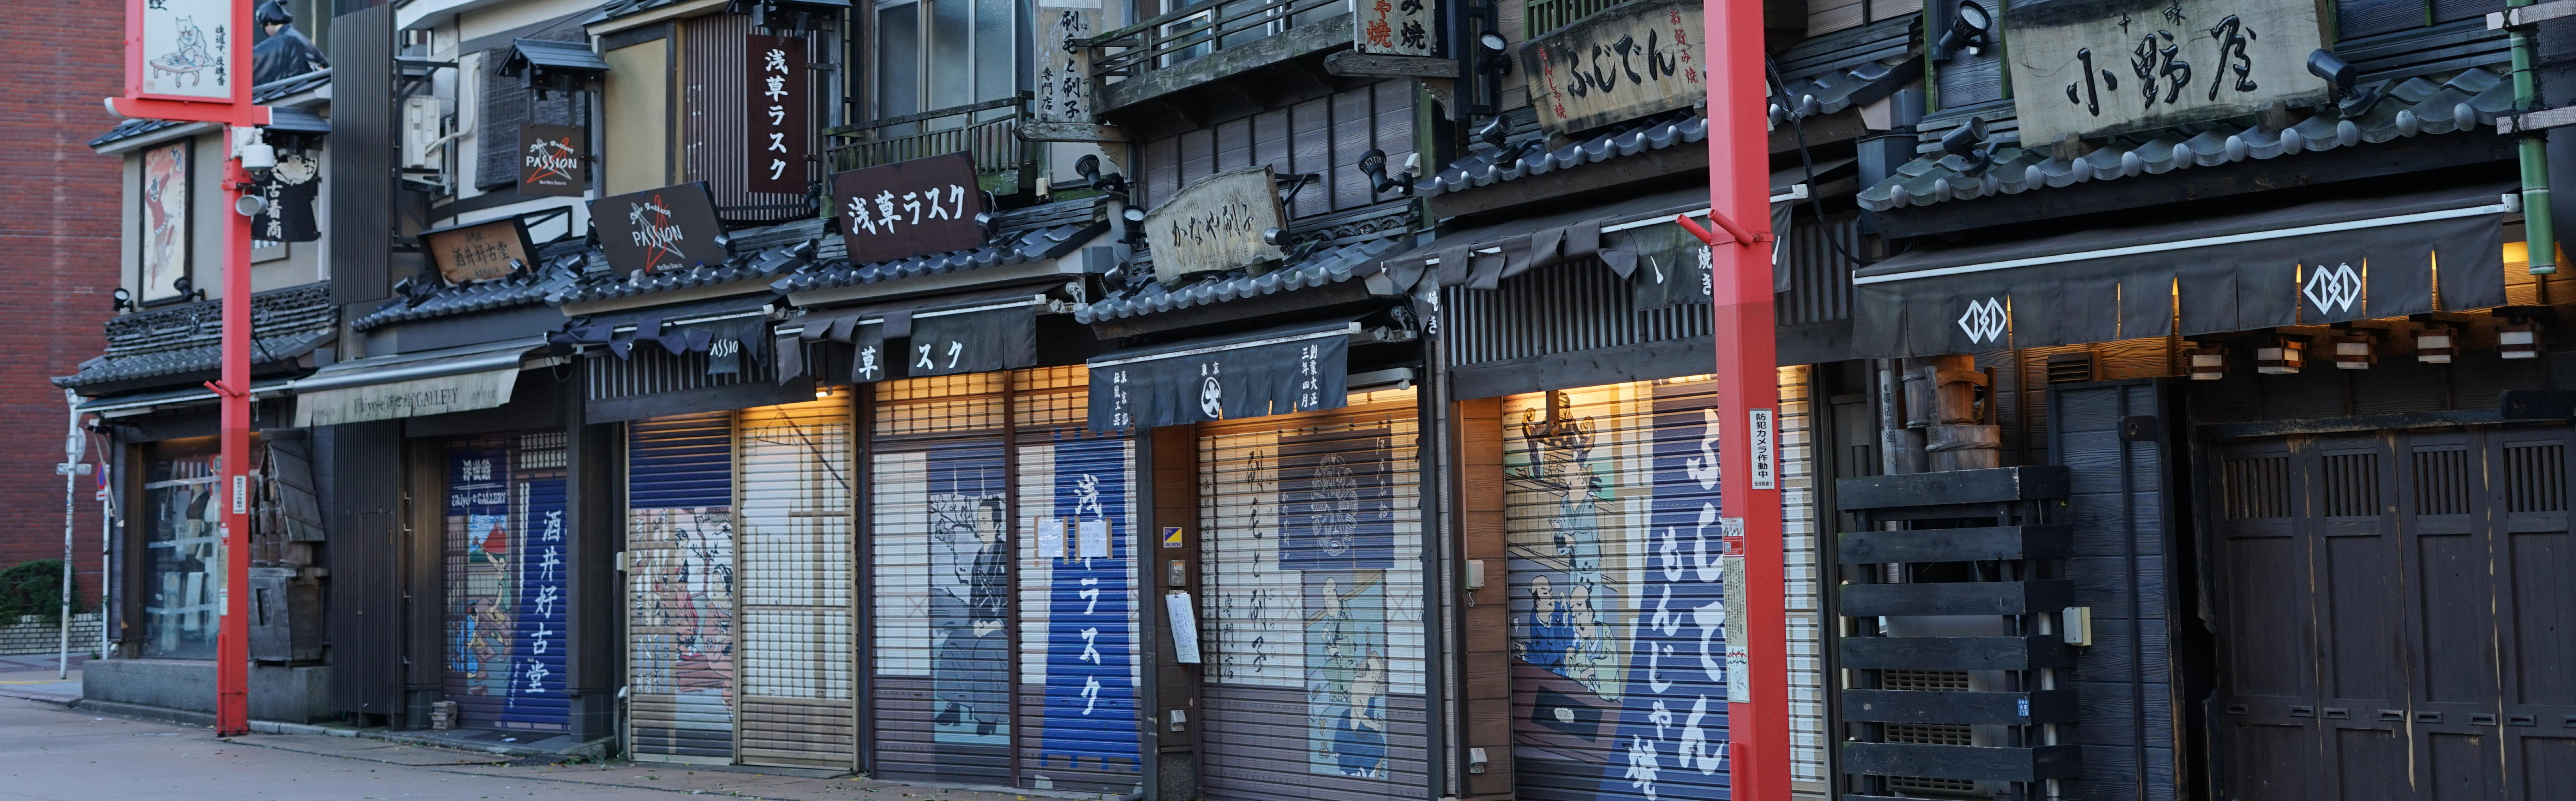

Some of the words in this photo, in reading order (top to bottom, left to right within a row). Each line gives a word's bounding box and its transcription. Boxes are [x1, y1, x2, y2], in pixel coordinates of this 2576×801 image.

[1060, 11, 1080, 118] 刷毛と刷子
[1567, 28, 1675, 97] ふじでん
[1670, 9, 1699, 84] お好み焼
[2067, 14, 2257, 117] 小野屋
[1041, 67, 1053, 111] 専門店
[1538, 46, 1567, 119] もんじゃ焼
[765, 48, 788, 180] 浅草ラスク
[526, 155, 577, 170] PASSION
[267, 182, 282, 239] 古着商
[632, 225, 683, 247] PASSION
[848, 184, 965, 235] 浅草ラスク
[453, 241, 510, 267] 酒井好古堂
[1697, 245, 1712, 295] 焼き
[709, 338, 739, 357] ASSIO
[859, 345, 878, 380] 草
[1201, 362, 1219, 376] 東京
[1310, 344, 1318, 406] 創業大正
[1756, 413, 1768, 478] 防犯カメラ作動中
[477, 492, 506, 504] GALLERY
[525, 510, 562, 693] 酒井好古堂
[1074, 474, 1103, 715] 浅ラスク
[1223, 591, 1235, 680] 専門店
[1625, 526, 1683, 800] もんじゃ焼
